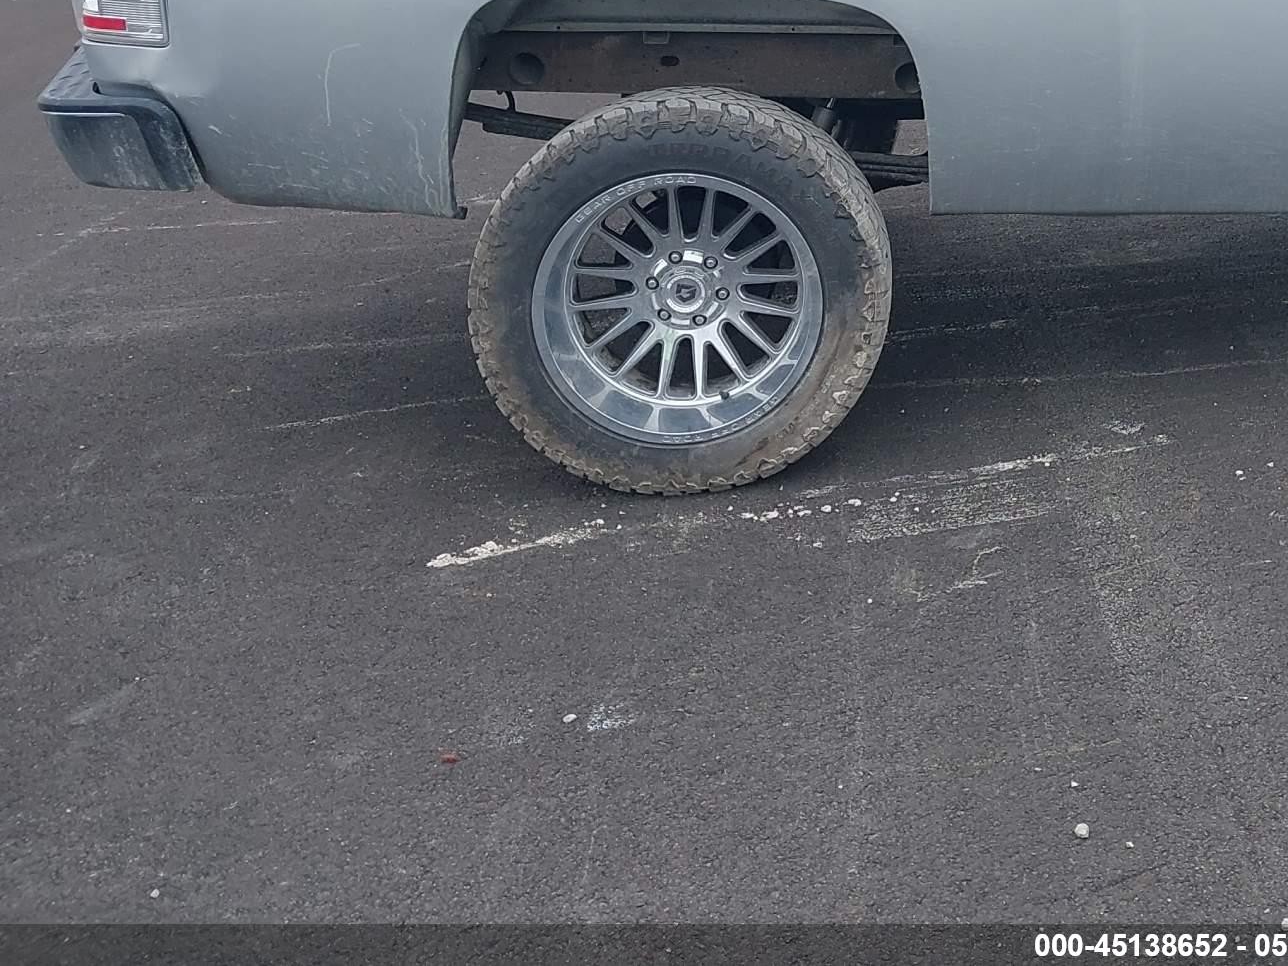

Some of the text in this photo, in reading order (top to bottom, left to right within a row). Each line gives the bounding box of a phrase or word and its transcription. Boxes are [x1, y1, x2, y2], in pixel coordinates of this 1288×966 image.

[574, 176, 697, 224] GEAR OFF ROAD
